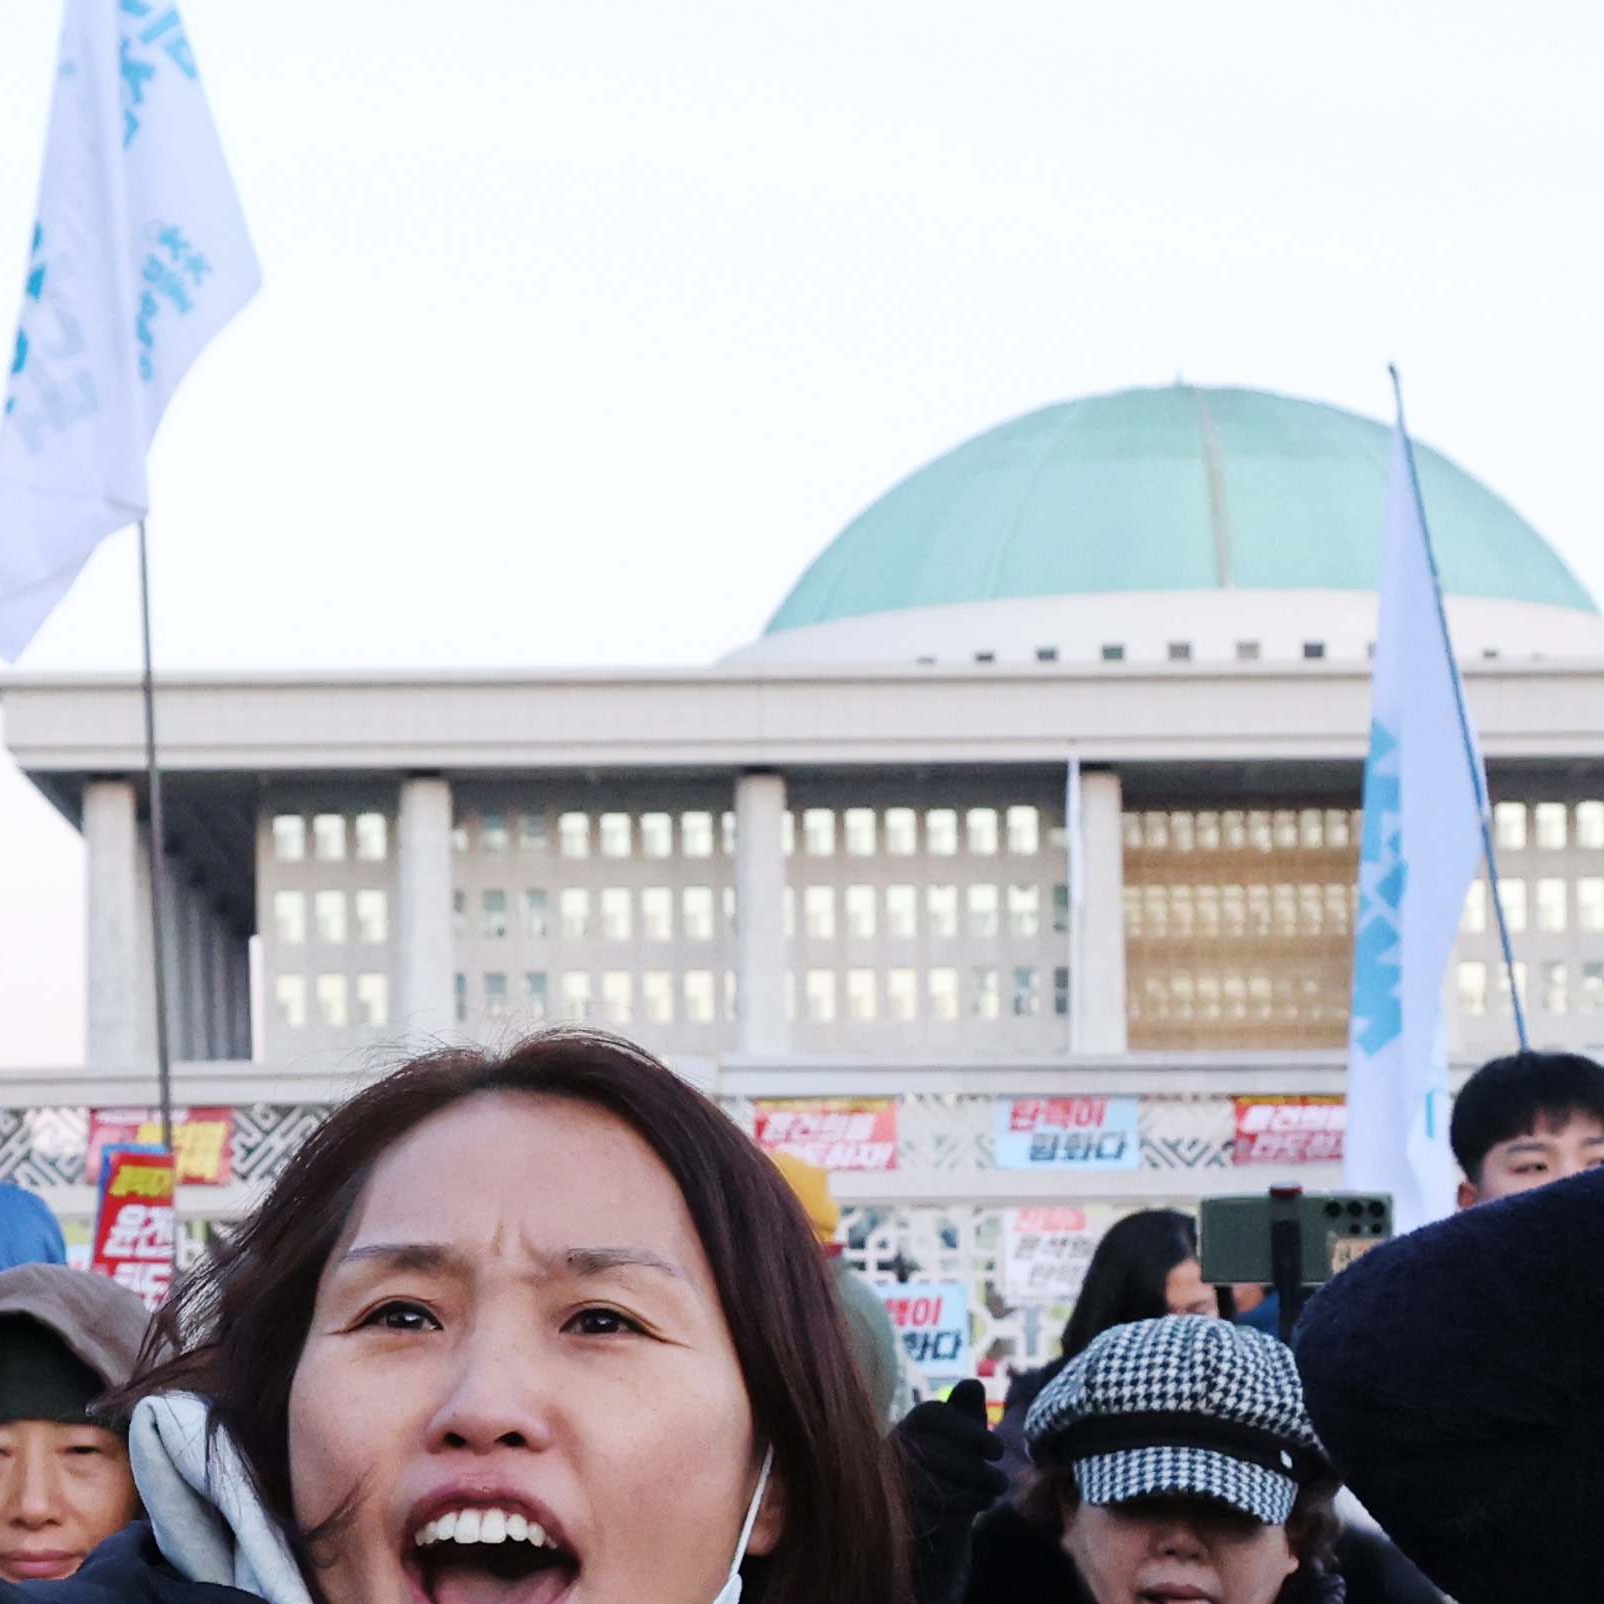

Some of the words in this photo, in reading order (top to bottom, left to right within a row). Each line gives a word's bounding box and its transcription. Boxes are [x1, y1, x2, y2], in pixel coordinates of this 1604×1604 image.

[1010, 1096, 1108, 1131] 탄핵이
[885, 1297, 943, 1328] 핵이
[901, 1331, 962, 1361] 화다
